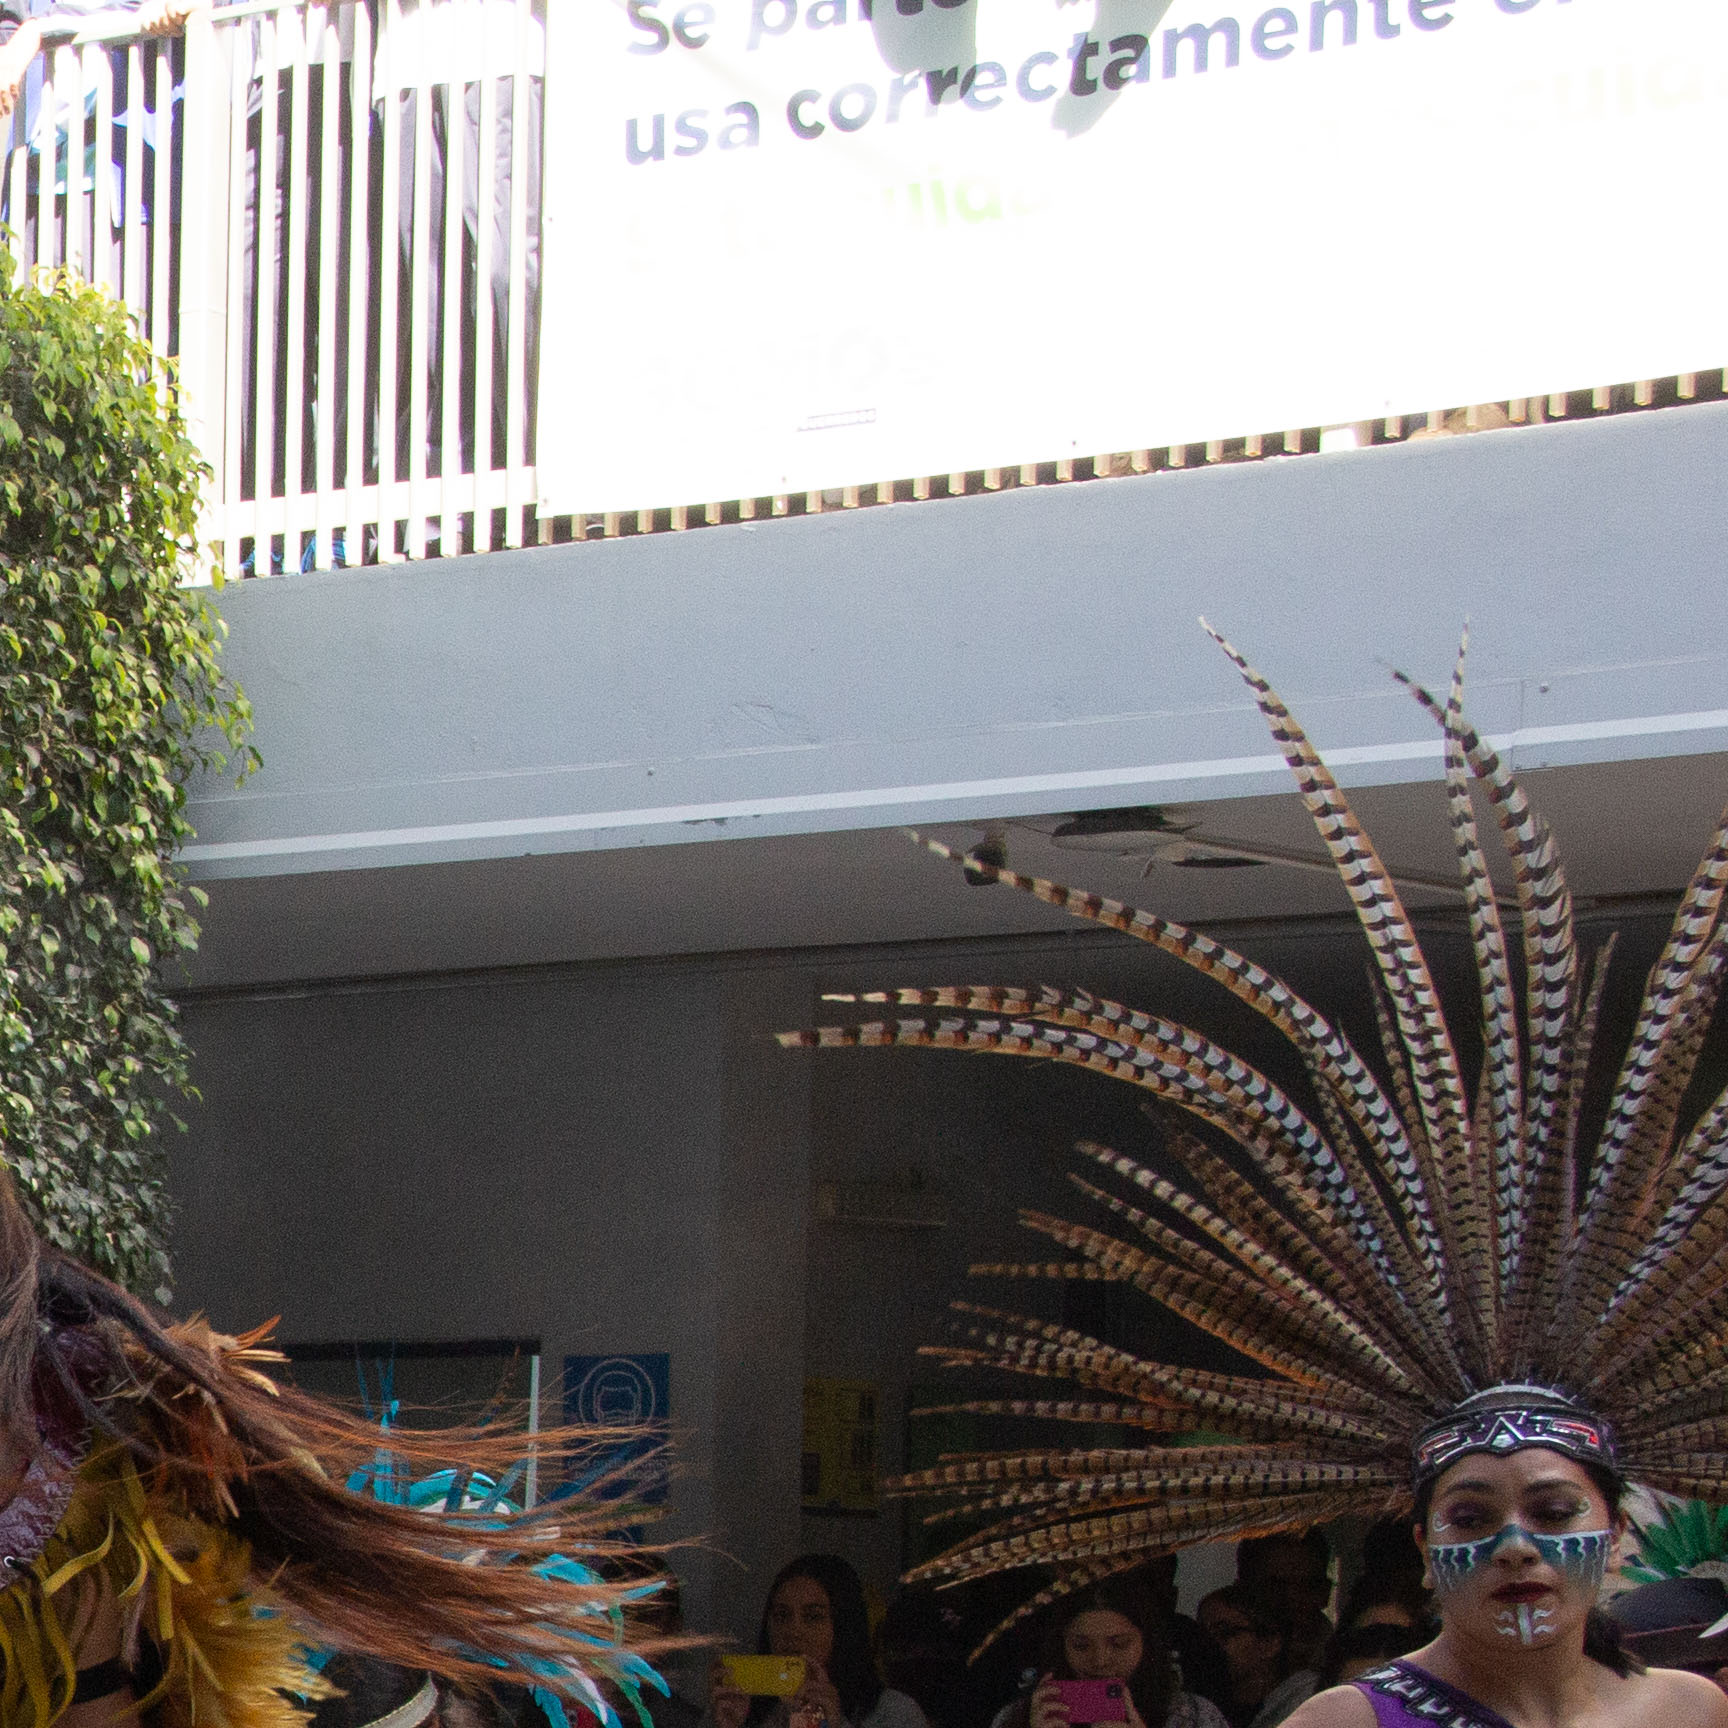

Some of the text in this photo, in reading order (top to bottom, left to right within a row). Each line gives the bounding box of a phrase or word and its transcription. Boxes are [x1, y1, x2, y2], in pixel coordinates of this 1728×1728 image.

[625, 101, 760, 165] usa
[786, 0, 1454, 140] correctamente
[626, 0, 715, 56] Se
